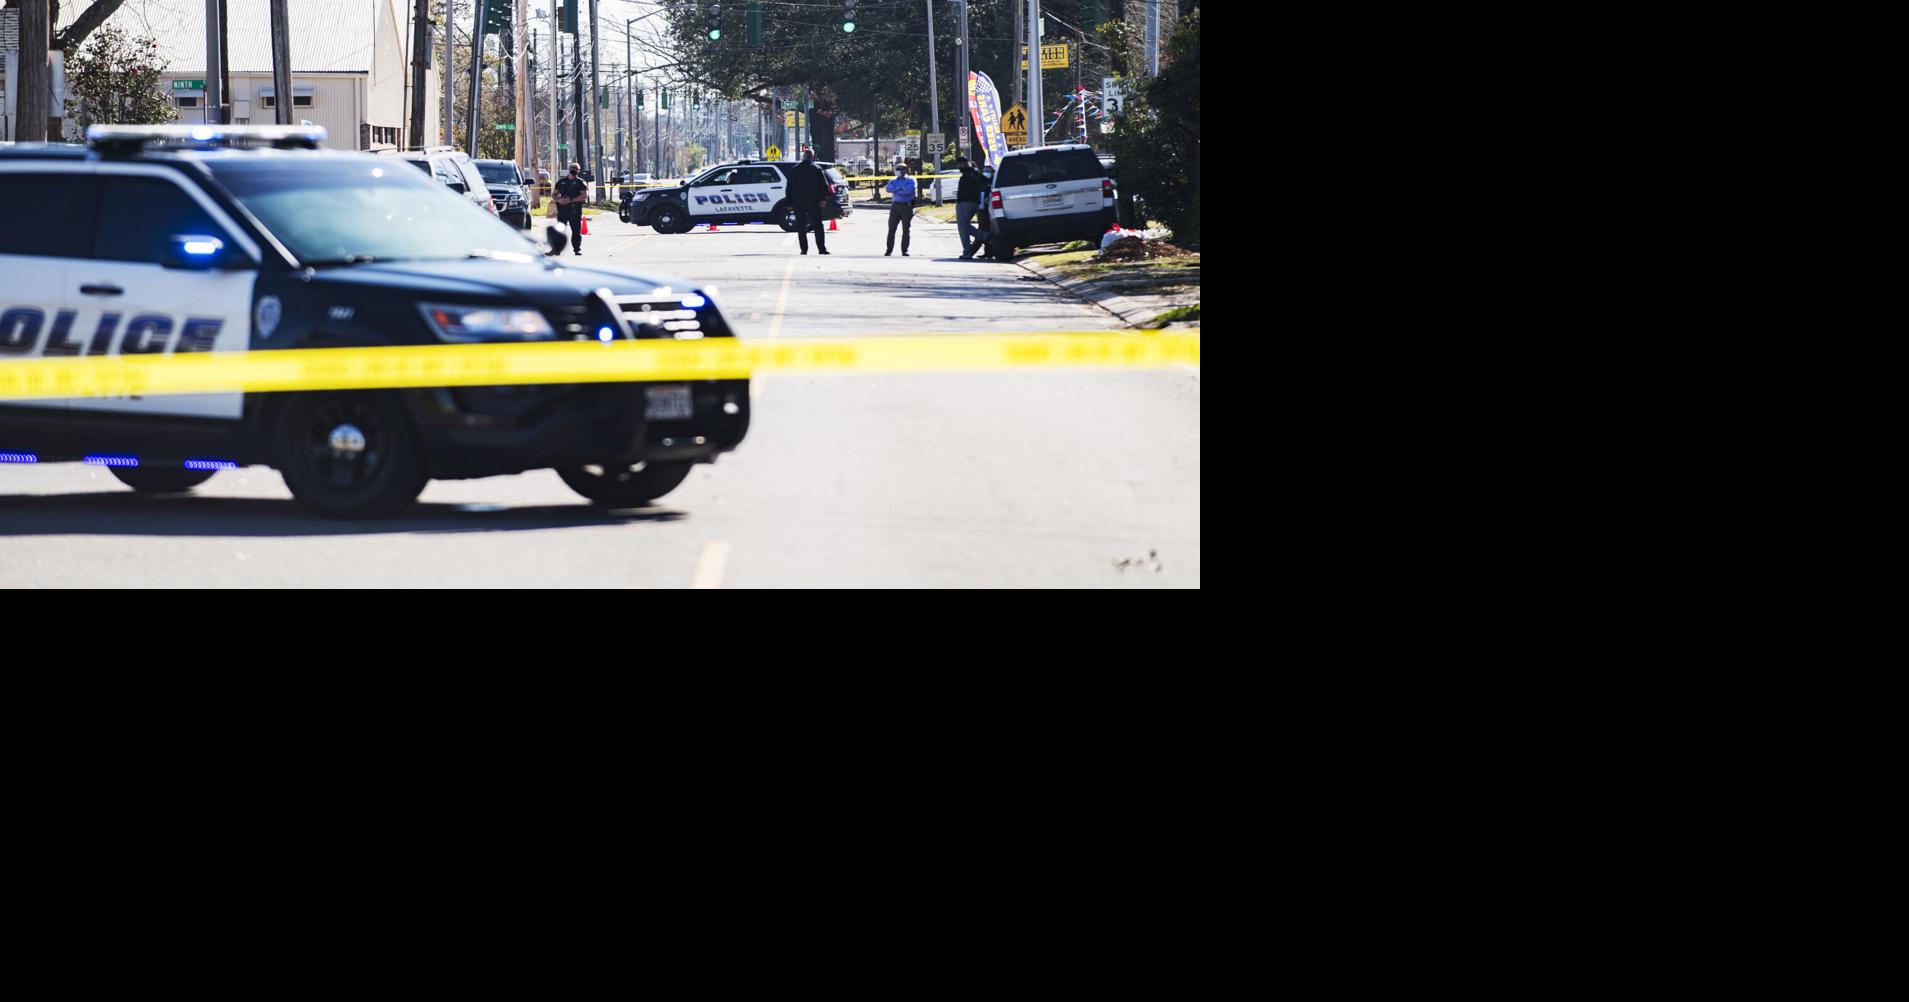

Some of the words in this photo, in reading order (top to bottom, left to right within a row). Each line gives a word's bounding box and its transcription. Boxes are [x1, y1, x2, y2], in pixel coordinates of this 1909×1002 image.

[173, 81, 193, 89] NINTH
[1106, 98, 1119, 112] 3
[906, 143, 919, 151] 25
[928, 143, 944, 152] 35
[694, 193, 770, 205] POLICE
